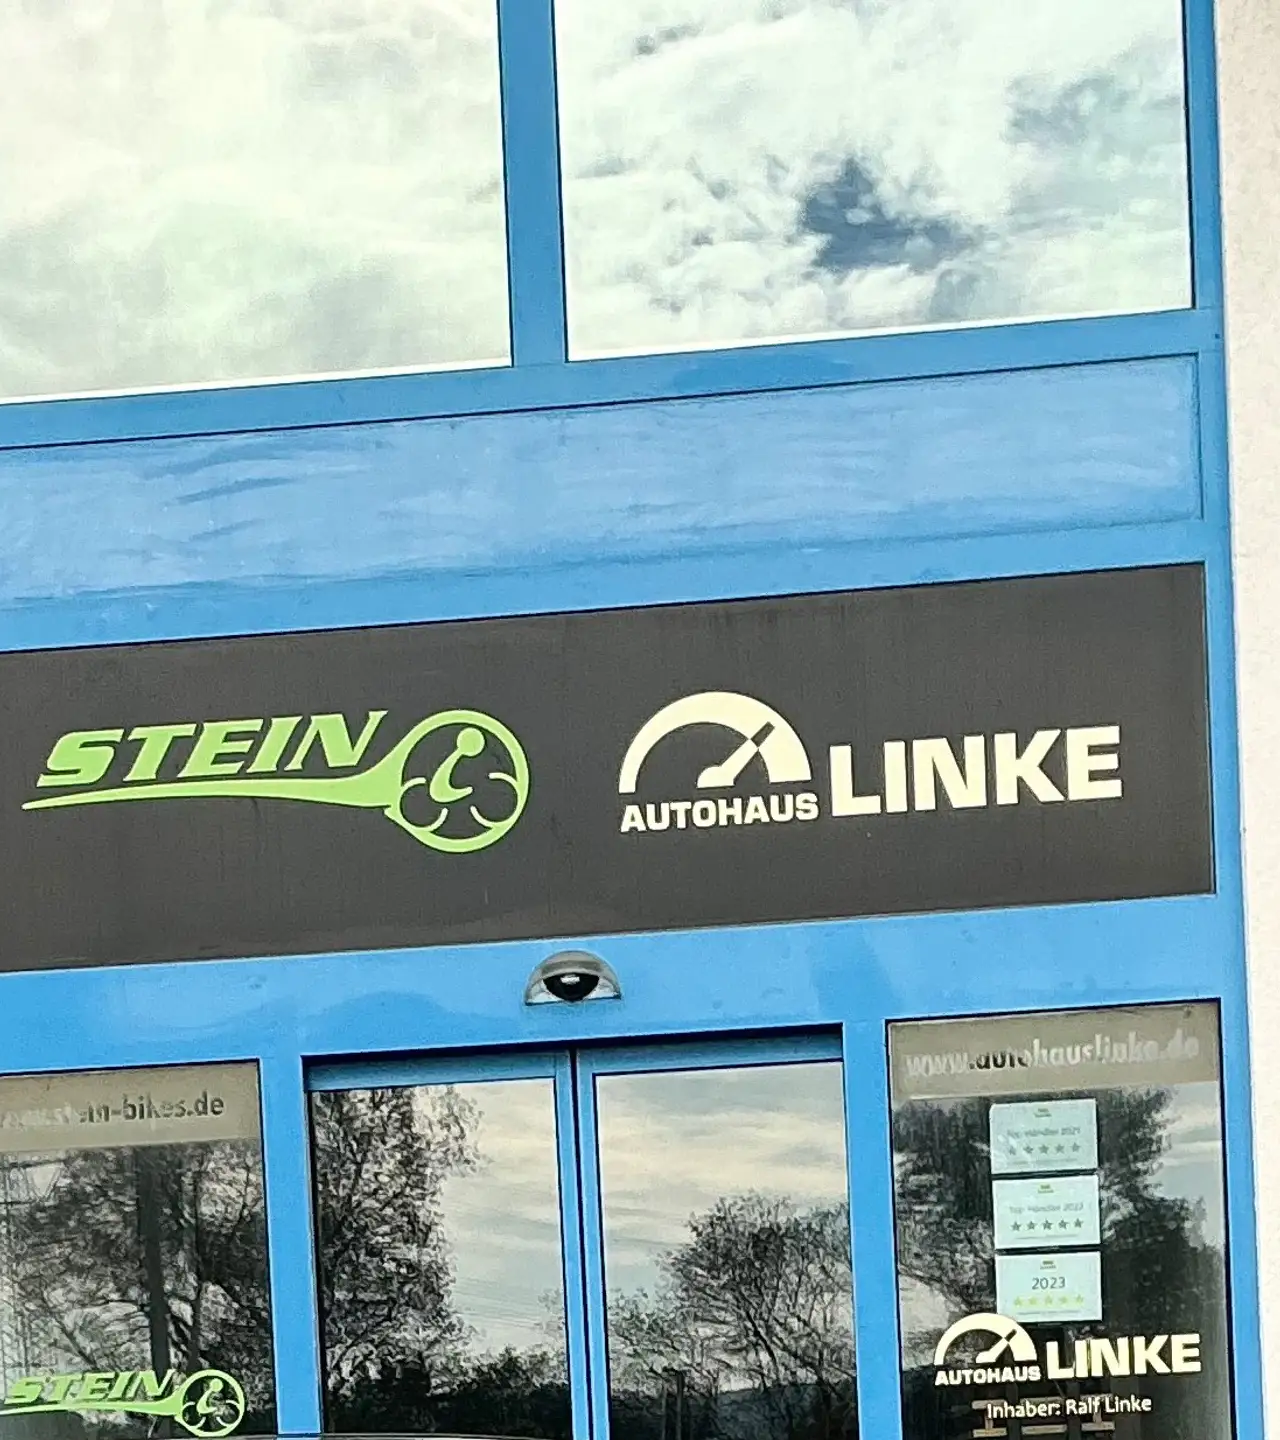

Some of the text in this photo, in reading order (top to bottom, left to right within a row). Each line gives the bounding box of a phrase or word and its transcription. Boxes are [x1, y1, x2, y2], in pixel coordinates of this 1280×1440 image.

[36, 710, 388, 788] STEIN
[619, 725, 1123, 833] AUTOHAUS LINKE
[1031, 1276, 1066, 1290] 2023
[934, 1333, 1201, 1386] AUTOHAUS LINKE
[4, 1369, 176, 1404] STEIN
[987, 1394, 1152, 1419] Inhaber: Ralf Linke
